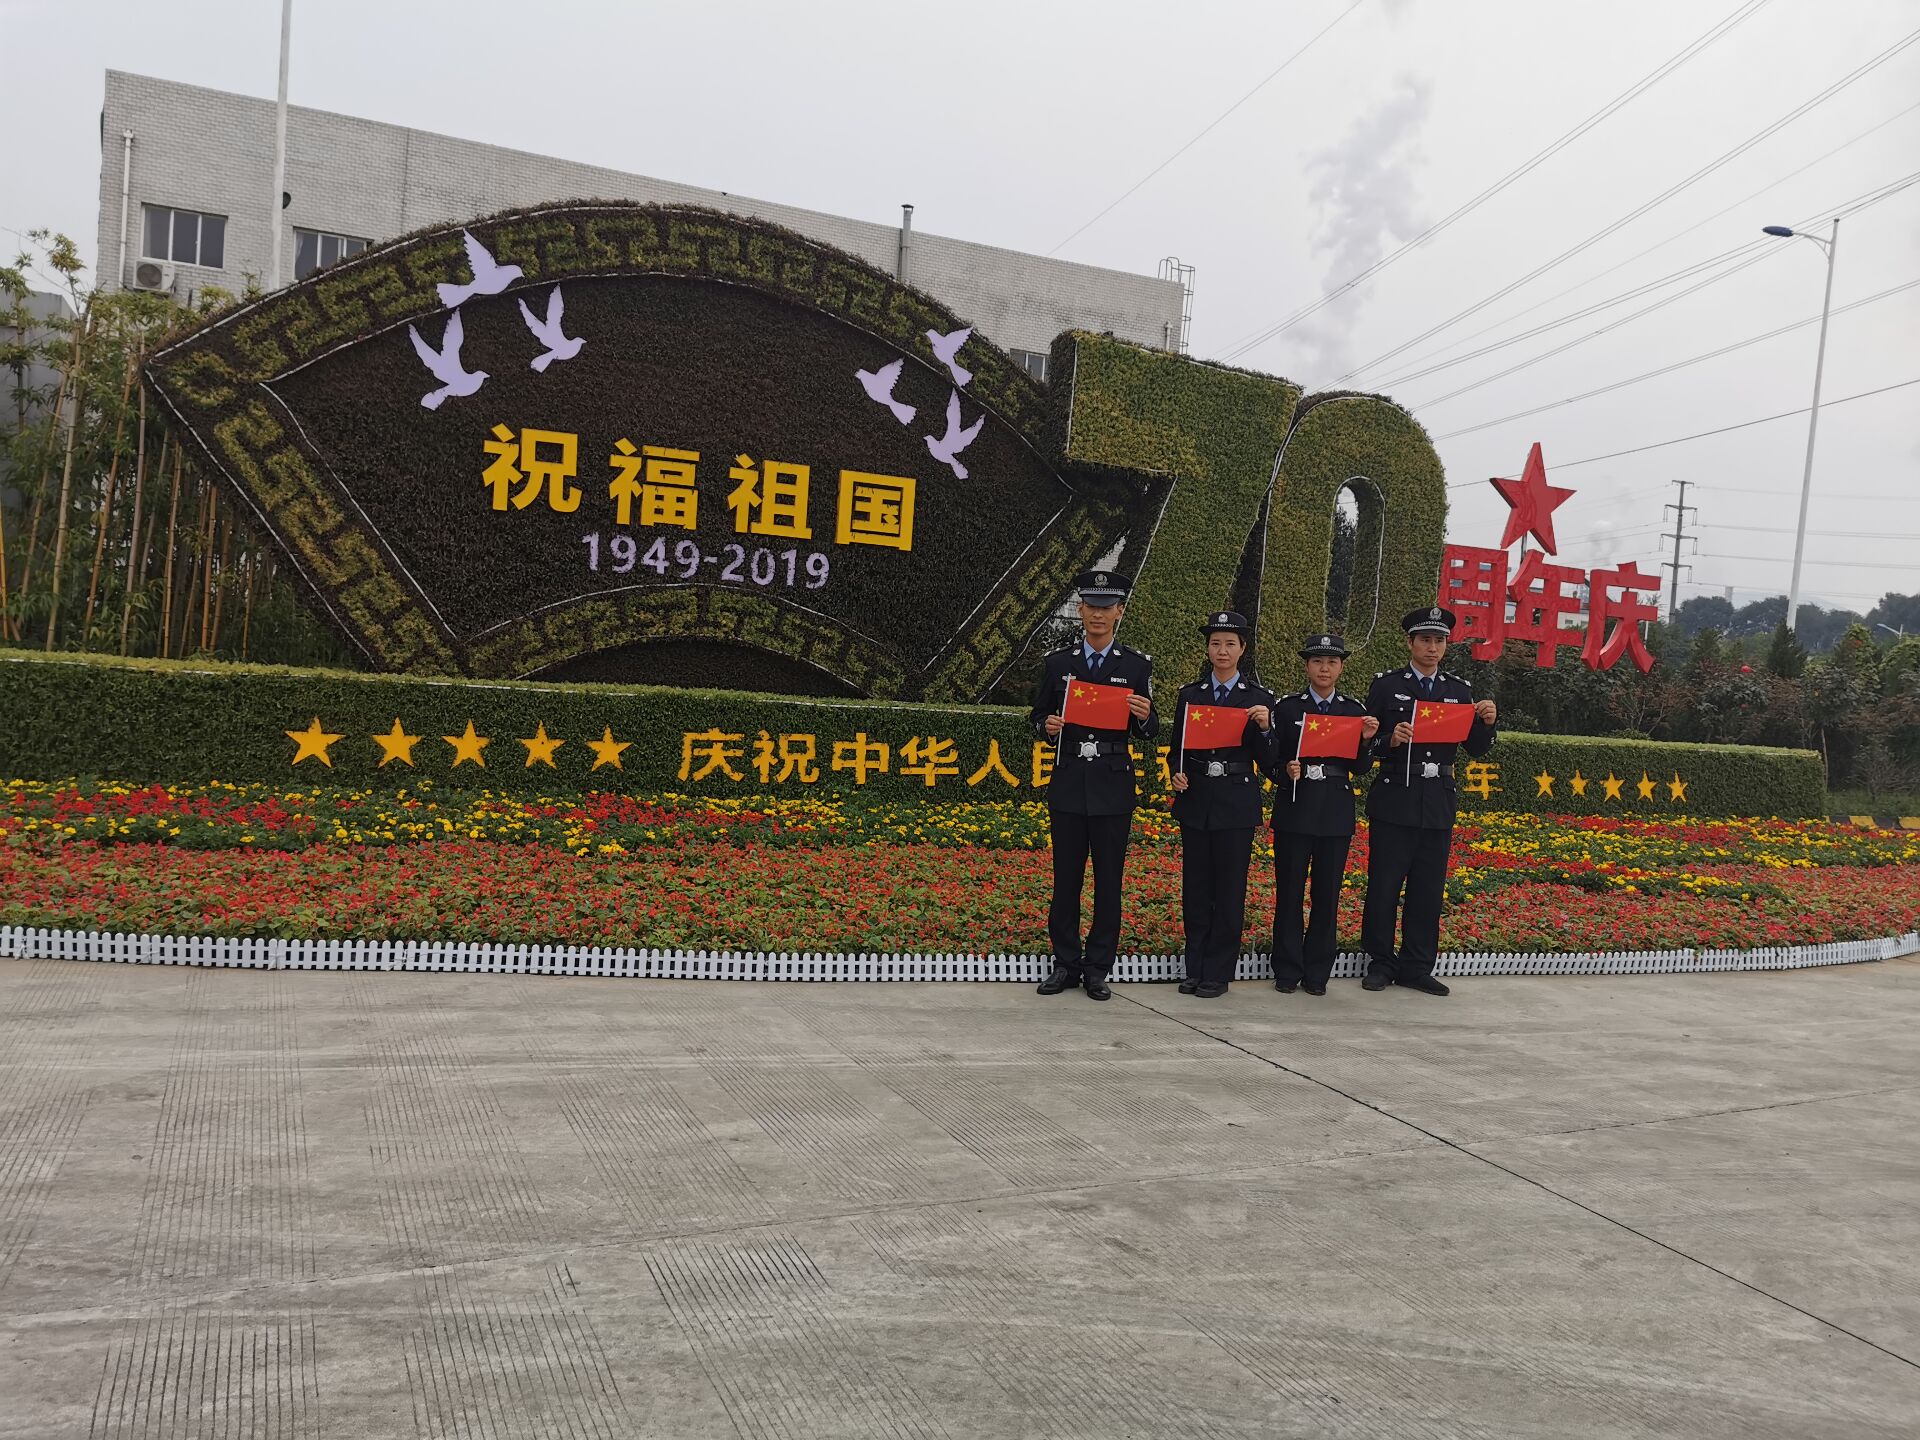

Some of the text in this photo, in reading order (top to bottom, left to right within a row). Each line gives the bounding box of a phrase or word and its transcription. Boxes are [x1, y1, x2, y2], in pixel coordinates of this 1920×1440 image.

[481, 423, 917, 551] 祝福祖国
[581, 531, 831, 590] 1949-2019
[1437, 544, 1662, 674] 周年庆
